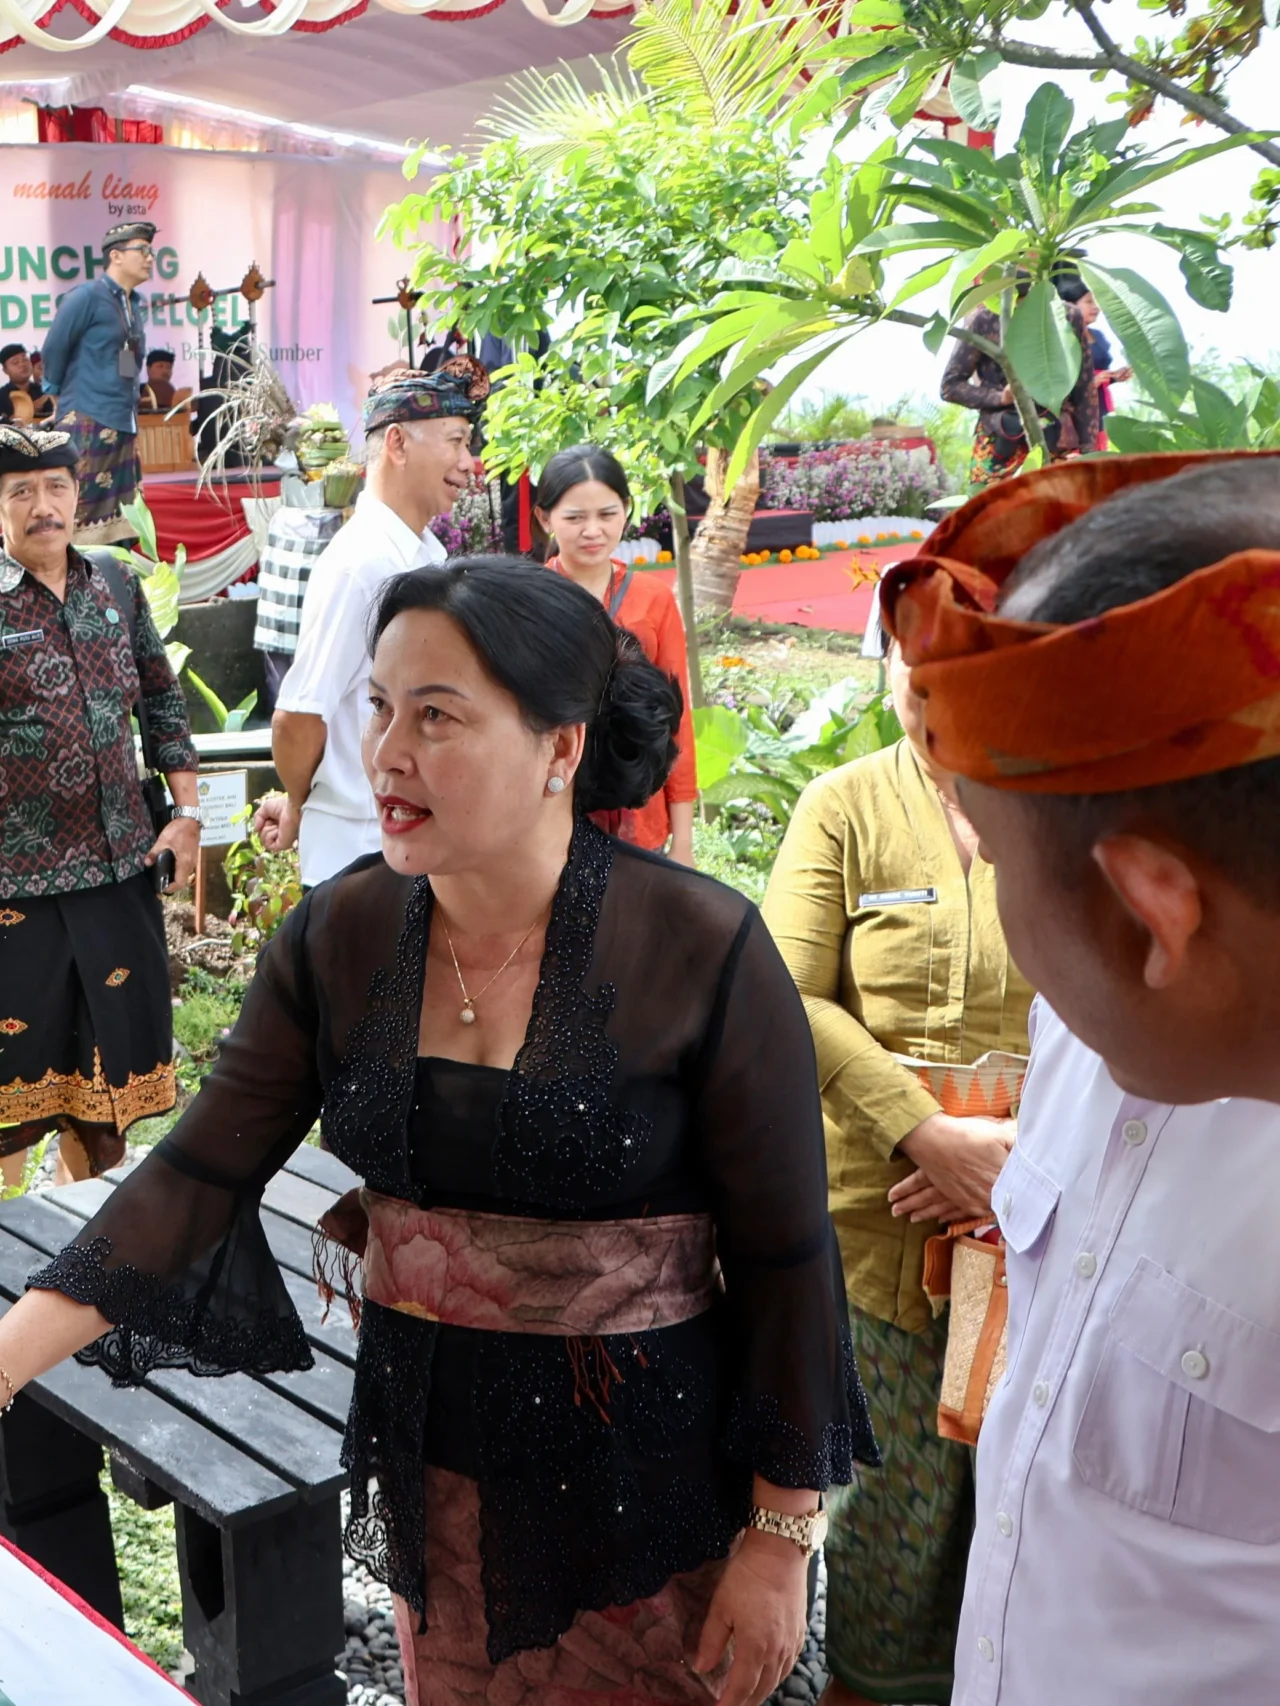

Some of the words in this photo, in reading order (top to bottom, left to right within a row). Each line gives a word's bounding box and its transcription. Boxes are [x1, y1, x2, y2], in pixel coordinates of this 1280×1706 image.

[13, 170, 93, 200] manah
[101, 173, 160, 211] liang
[108, 202, 124, 217] by
[126, 204, 147, 216] asta
[258, 342, 324, 363] Sumber
